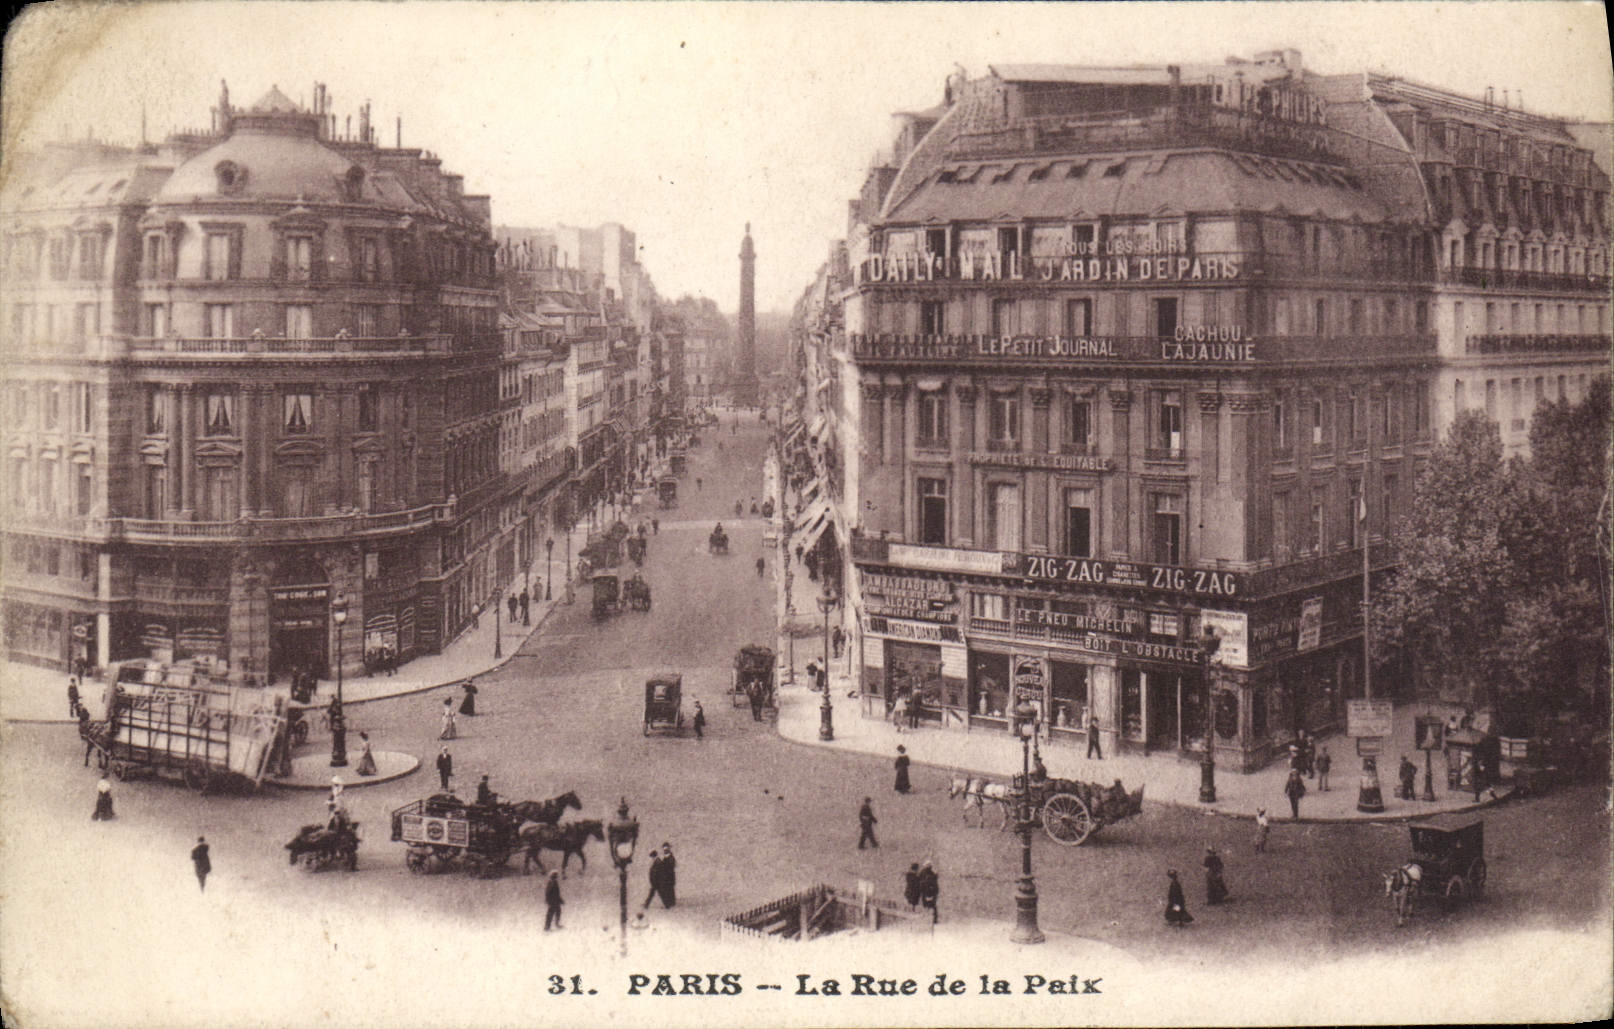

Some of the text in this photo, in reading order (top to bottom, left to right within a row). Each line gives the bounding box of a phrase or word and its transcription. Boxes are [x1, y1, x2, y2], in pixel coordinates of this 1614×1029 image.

[871, 250, 1023, 282] DAILY MAIL
[1041, 257, 1239, 281] JARDIN DE PARIS
[978, 334, 1118, 358] LE PETIT JOURNAL
[1174, 326, 1242, 343] CACHOU
[1161, 343, 1256, 361] LAJAUNIE
[1017, 608, 1031, 622] LE
[1038, 612, 1068, 626] PNEU
[1075, 615, 1132, 634] MICHELIN
[1084, 638, 1111, 652] BOIT
